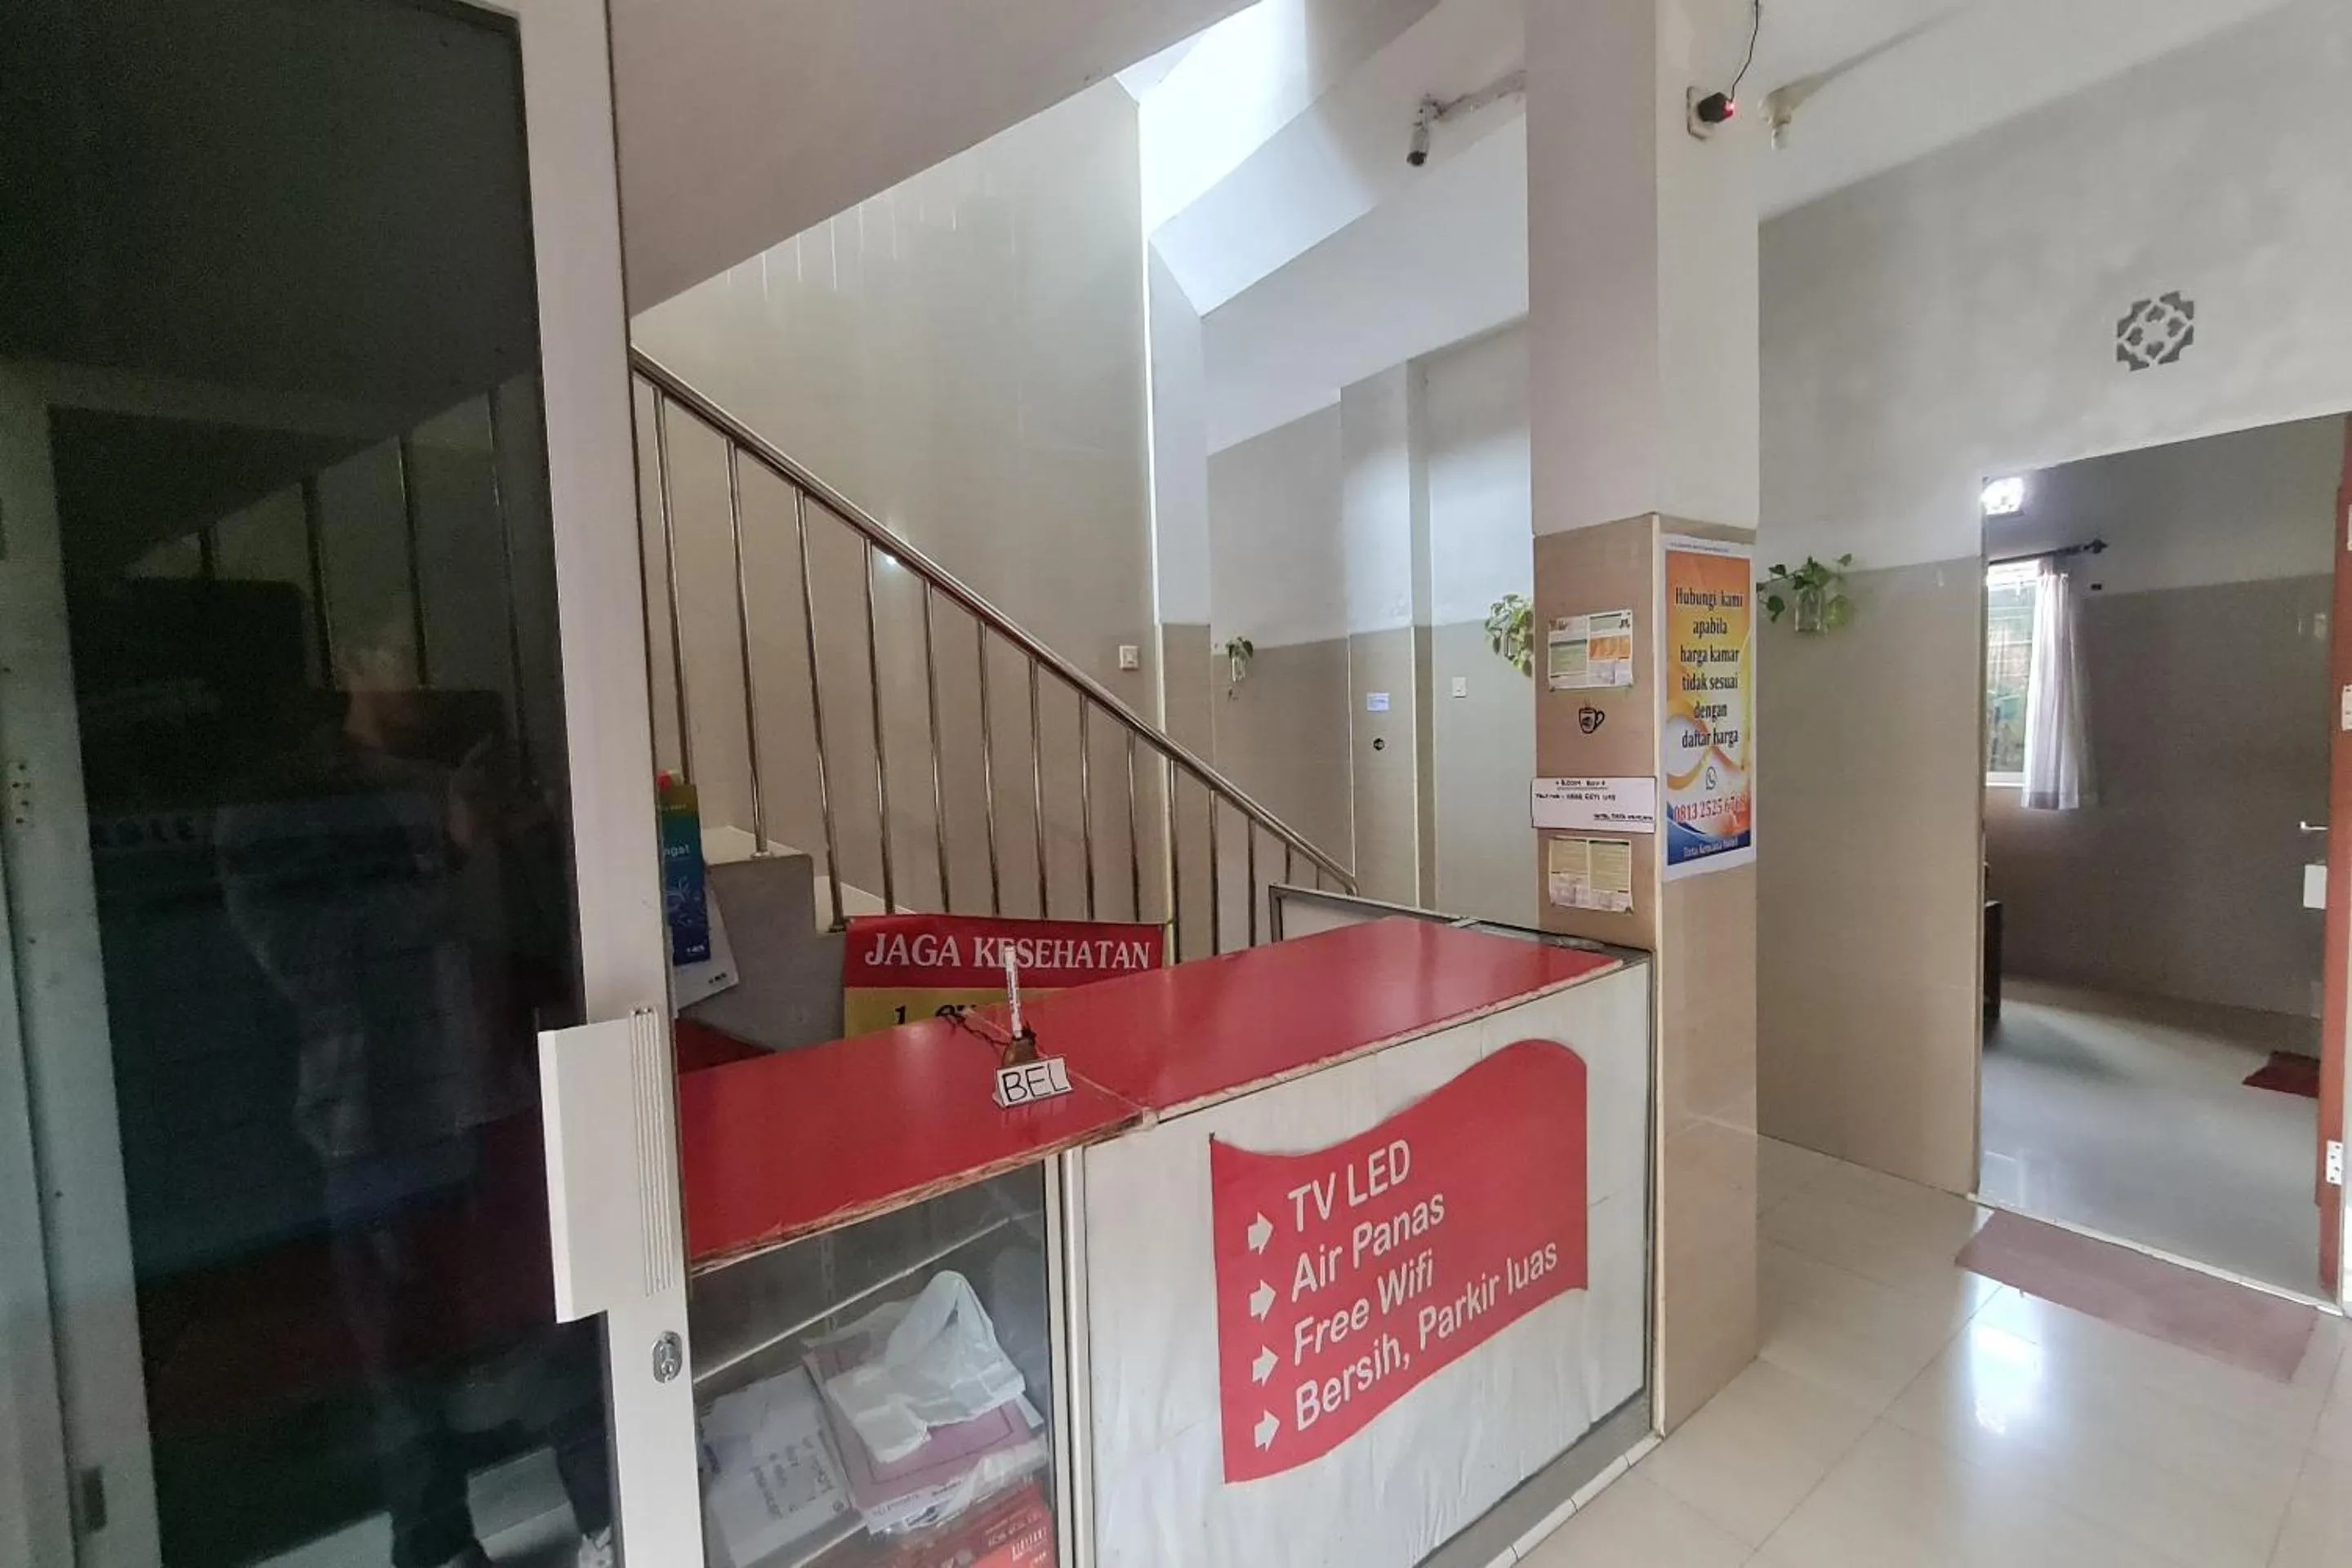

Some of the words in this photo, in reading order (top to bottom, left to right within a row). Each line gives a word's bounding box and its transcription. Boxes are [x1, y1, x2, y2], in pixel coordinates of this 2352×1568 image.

[1675, 587, 1717, 611] Hubungi
[1721, 589, 1744, 608] kami
[1692, 617, 1728, 639] apabila
[1680, 644, 1708, 666] harga
[1709, 644, 1740, 663] kamar
[1682, 672, 1708, 692] tidak
[1708, 672, 1739, 691] sesuai
[1694, 700, 1728, 722] dengan
[1682, 729, 1711, 749] daftar
[1713, 728, 1739, 749] harga
[1673, 802, 1698, 823] 0813
[865, 933, 961, 967] JAGA
[973, 936, 1152, 969] KESEHATAN
[1001, 1062, 1069, 1102] BEL
[1288, 1170, 1338, 1233] TV
[1346, 1138, 1411, 1208] LED
[1290, 1245, 1343, 1303] Air
[1352, 1193, 1446, 1270] Panas
[1294, 1298, 1369, 1366] Free
[1376, 1249, 1435, 1316] Wifi
[1295, 1334, 1411, 1432] Bersih,
[1419, 1275, 1501, 1352] Parkir
[1504, 1241, 1559, 1297] luas
